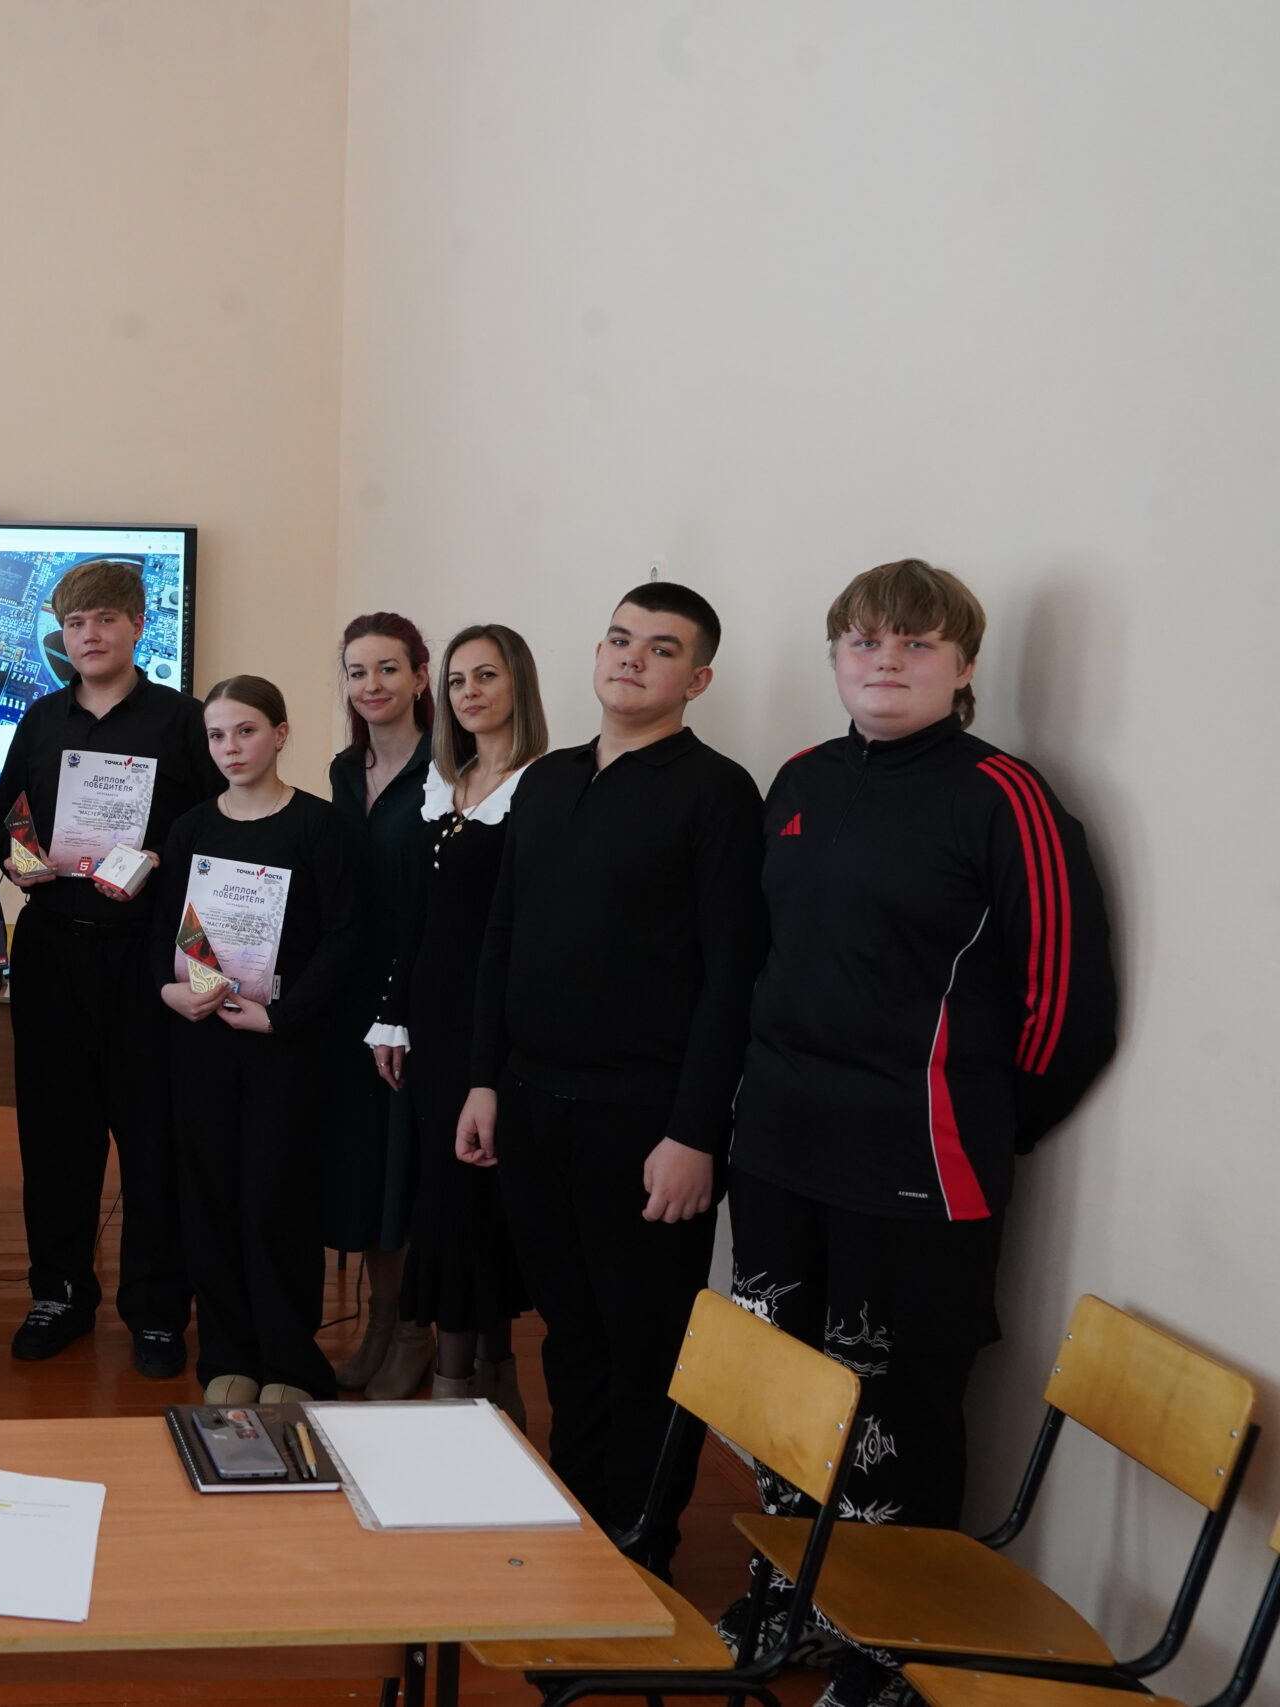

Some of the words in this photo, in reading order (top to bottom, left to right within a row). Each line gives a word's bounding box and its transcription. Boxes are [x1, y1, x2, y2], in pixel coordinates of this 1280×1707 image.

[93, 775, 126, 784] ДИПЛОМ
[83, 782, 133, 793] ПОБЕДИТЕЛЯ
[236, 868, 255, 876] ТОЧКА
[223, 884, 257, 896] ДИПЛОМ
[213, 891, 265, 904] ПОБЕДИТЕЛЯ
[898, 1190, 928, 1198] AEROREADY
